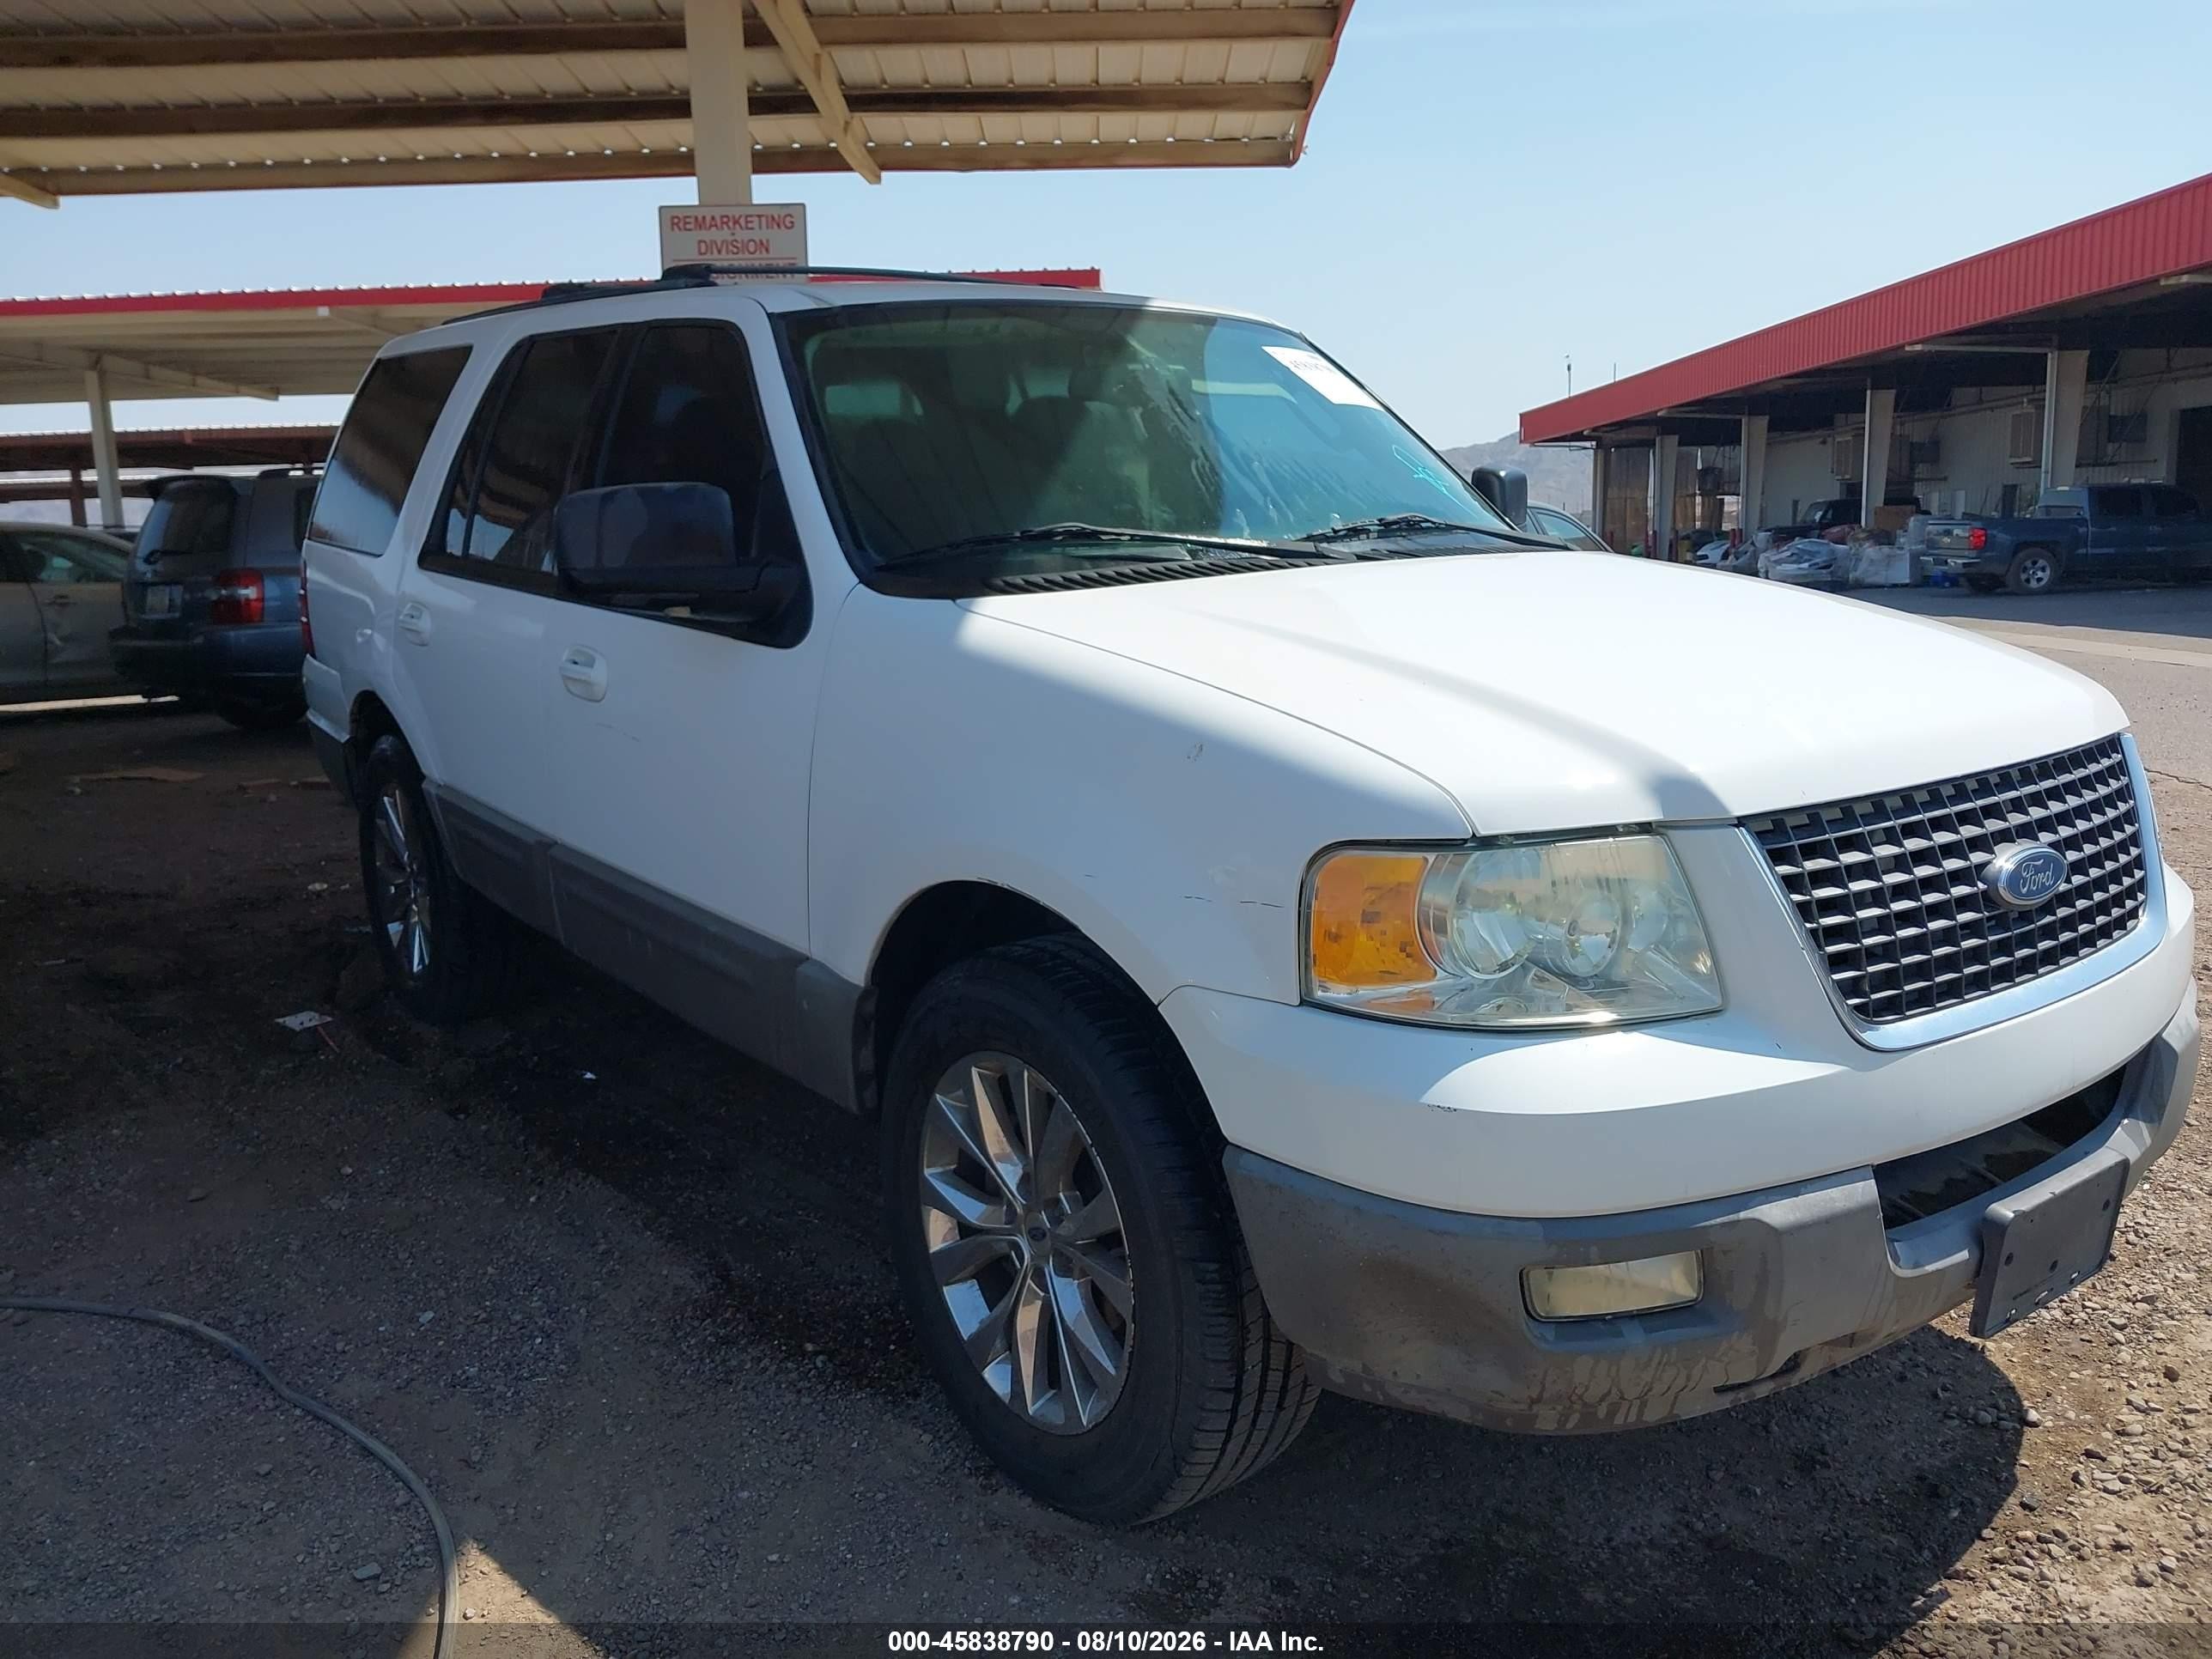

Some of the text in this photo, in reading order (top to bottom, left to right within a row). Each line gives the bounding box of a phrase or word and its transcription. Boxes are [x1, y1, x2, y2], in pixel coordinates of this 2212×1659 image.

[671, 214, 795, 232] REMARKETING
[698, 239, 770, 256] DIVISION
[2020, 859, 2055, 894] Ford
